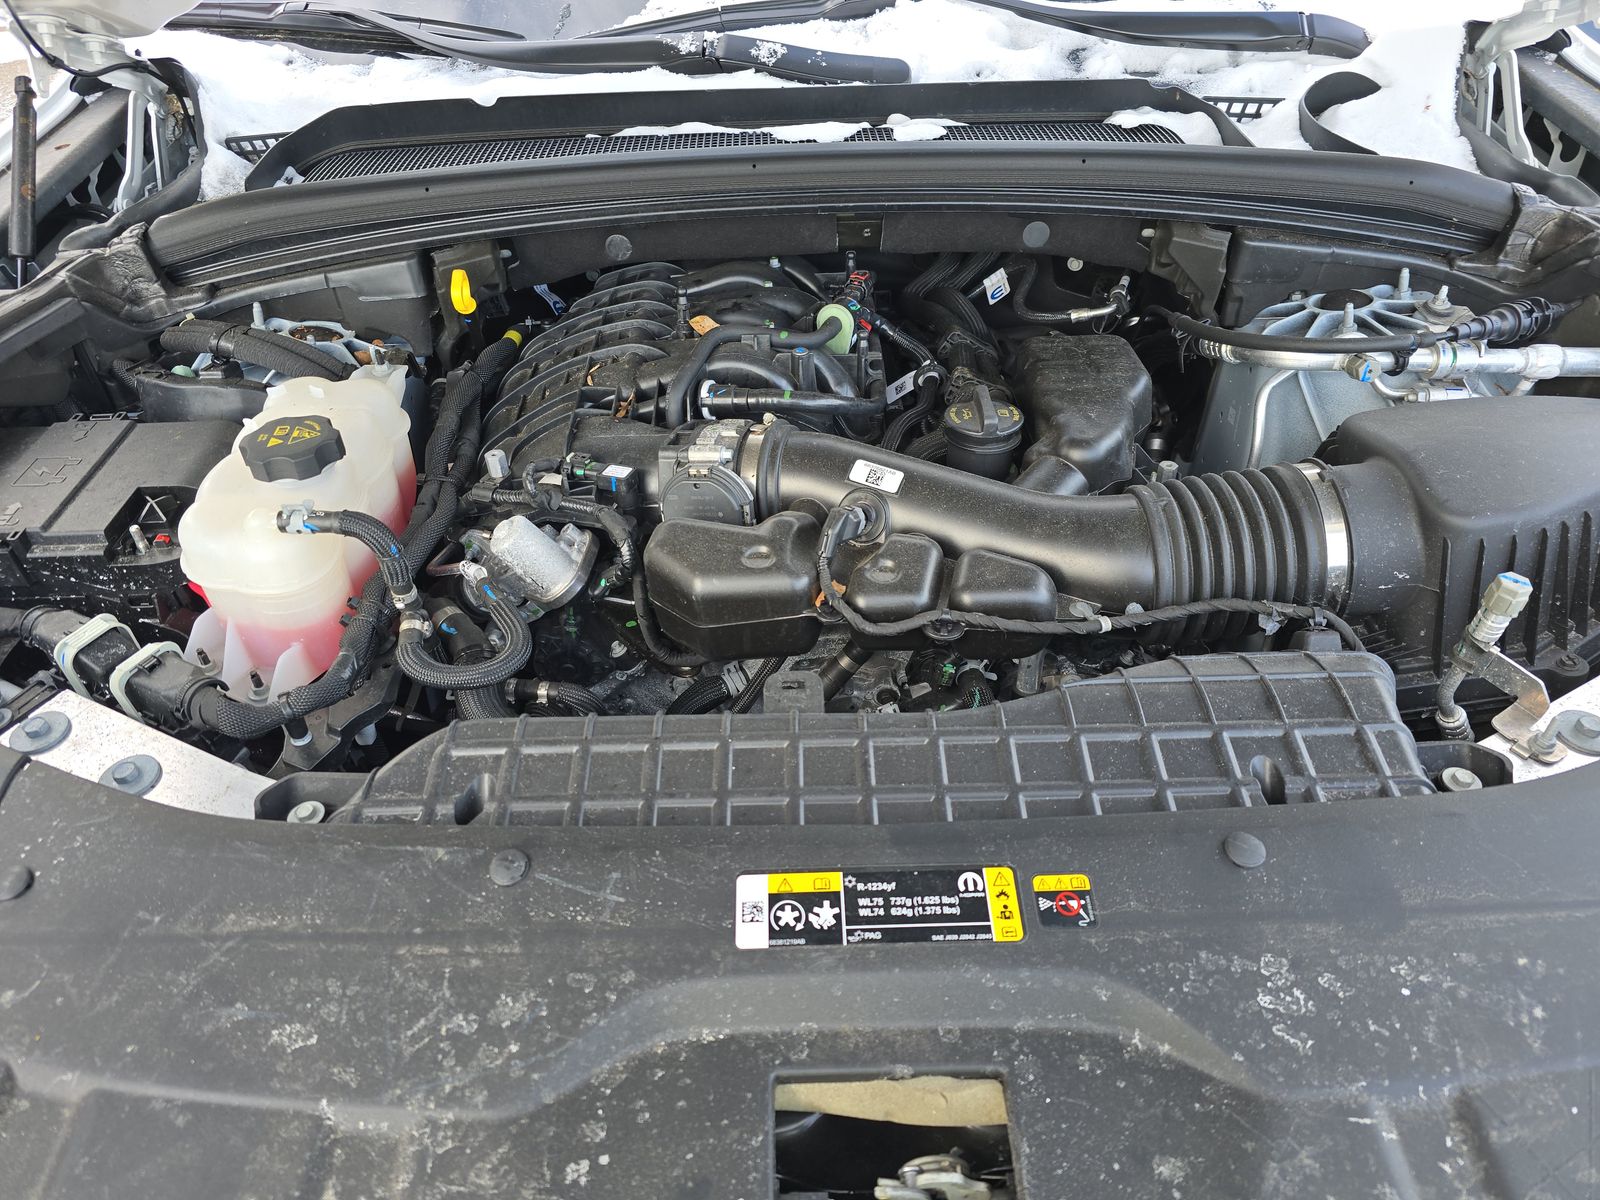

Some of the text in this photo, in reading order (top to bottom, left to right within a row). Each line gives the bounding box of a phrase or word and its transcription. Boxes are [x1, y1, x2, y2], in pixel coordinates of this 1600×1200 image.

[856, 881, 897, 892] R-1234yf
[857, 897, 885, 907] WL75
[889, 896, 913, 907] 737g
[941, 895, 960, 906] lbs)
[857, 907, 885, 917] WL74
[914, 906, 942, 917] (1.375
[942, 905, 961, 916] lbs)
[864, 931, 882, 940] PAG
